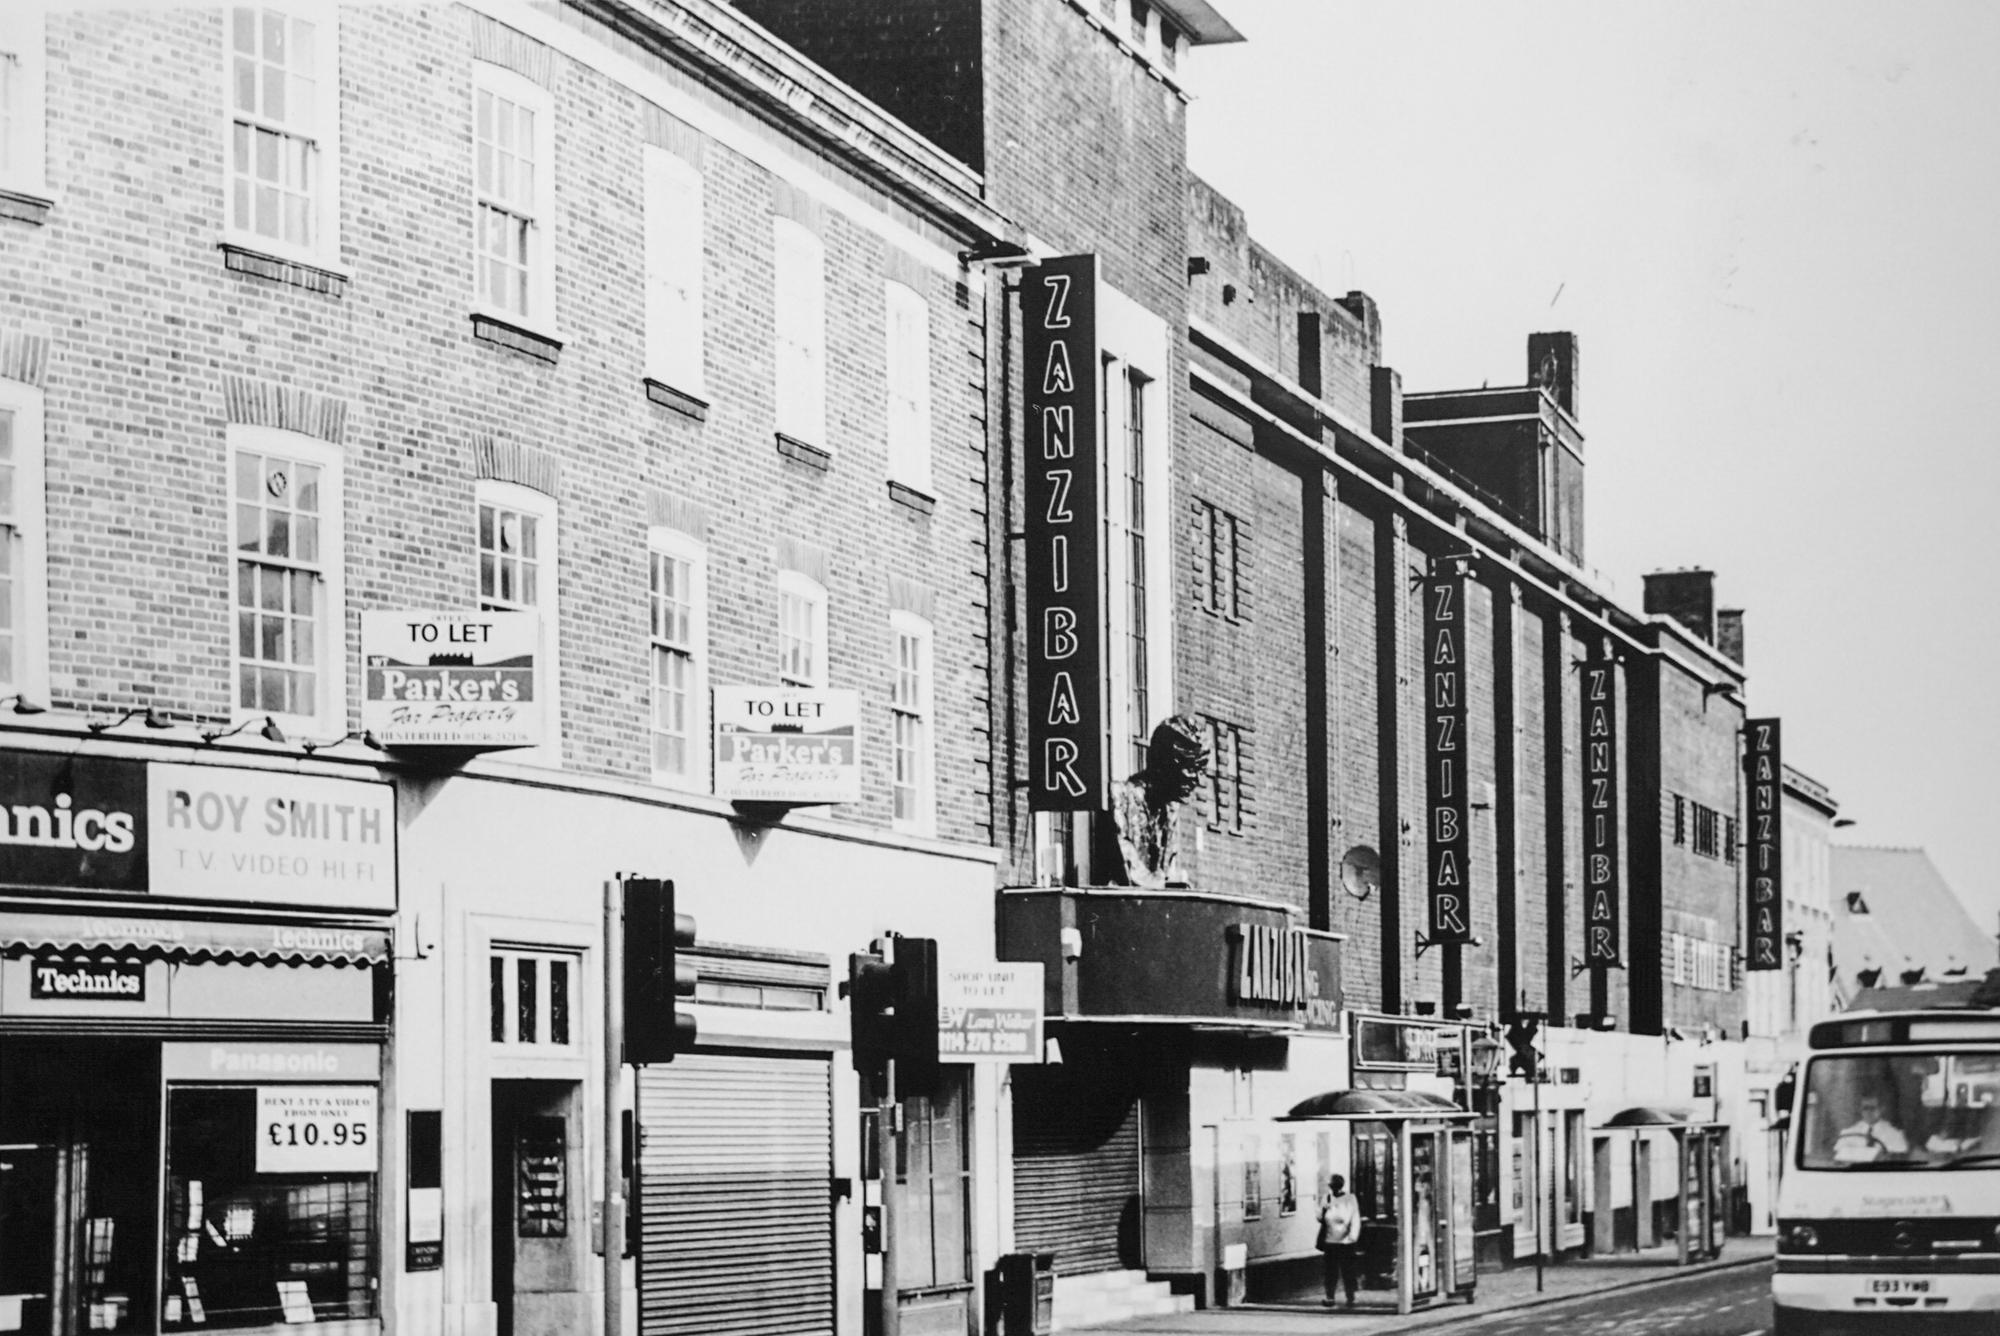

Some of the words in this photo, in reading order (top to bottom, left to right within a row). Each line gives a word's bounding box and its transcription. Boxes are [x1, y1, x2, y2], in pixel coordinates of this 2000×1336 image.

[1043, 275, 1086, 796] ZANZIBAR
[407, 624, 438, 642] TO
[450, 624, 493, 642] LET
[382, 670, 519, 701] Parker's
[745, 700, 774, 717] TO
[785, 702, 824, 717] LET
[731, 736, 842, 764] Parker's
[1434, 585, 1465, 933] ZANZIBAR
[0, 792, 135, 852] nics
[166, 790, 249, 833] ROY
[264, 797, 382, 844] SMITH
[1589, 670, 1615, 959] ZANZIBAR
[1755, 725, 1776, 964] ZANZIBAR
[231, 852, 308, 876] VIDEO
[272, 927, 363, 951] Technics
[37, 965, 141, 994] Technics
[210, 1048, 339, 1073] Panasonic
[268, 1122, 367, 1146] £10.95
